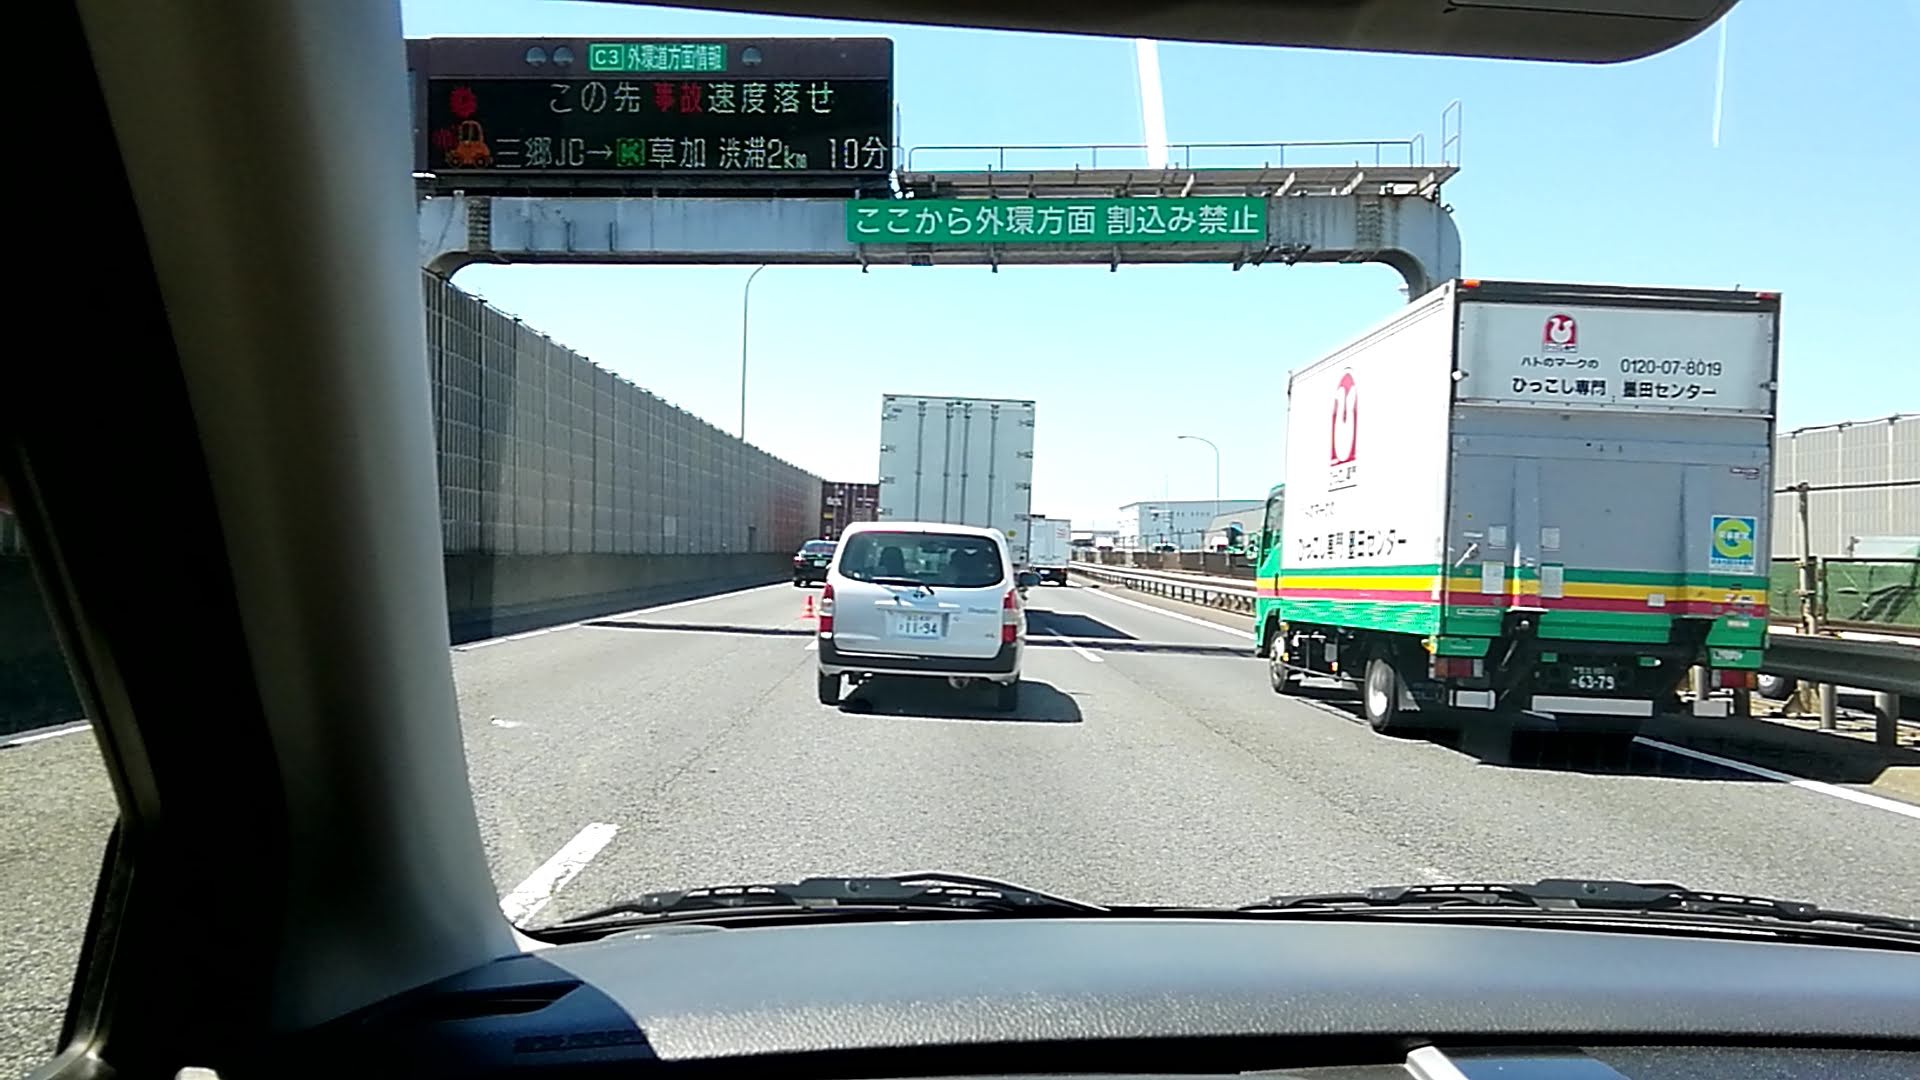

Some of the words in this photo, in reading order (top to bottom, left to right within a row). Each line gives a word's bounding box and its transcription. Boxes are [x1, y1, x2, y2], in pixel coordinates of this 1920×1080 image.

[595, 49, 619, 65] C3
[628, 44, 722, 71] 外環道方面情報
[549, 81, 641, 113] この先
[653, 81, 703, 114] 事故
[707, 81, 834, 114] 速度落せ
[495, 136, 585, 168] 三郷JC
[648, 136, 706, 169] 草加
[718, 136, 808, 169] 渋滞2km
[829, 136, 888, 169] 10分
[855, 205, 1096, 236] ここから外環方面
[1107, 204, 1259, 236] 割込み禁止
[1521, 356, 1599, 370] ハトのマークの
[1620, 359, 1722, 376] 0120-07-8019
[1511, 377, 1606, 397] ひっこし専門
